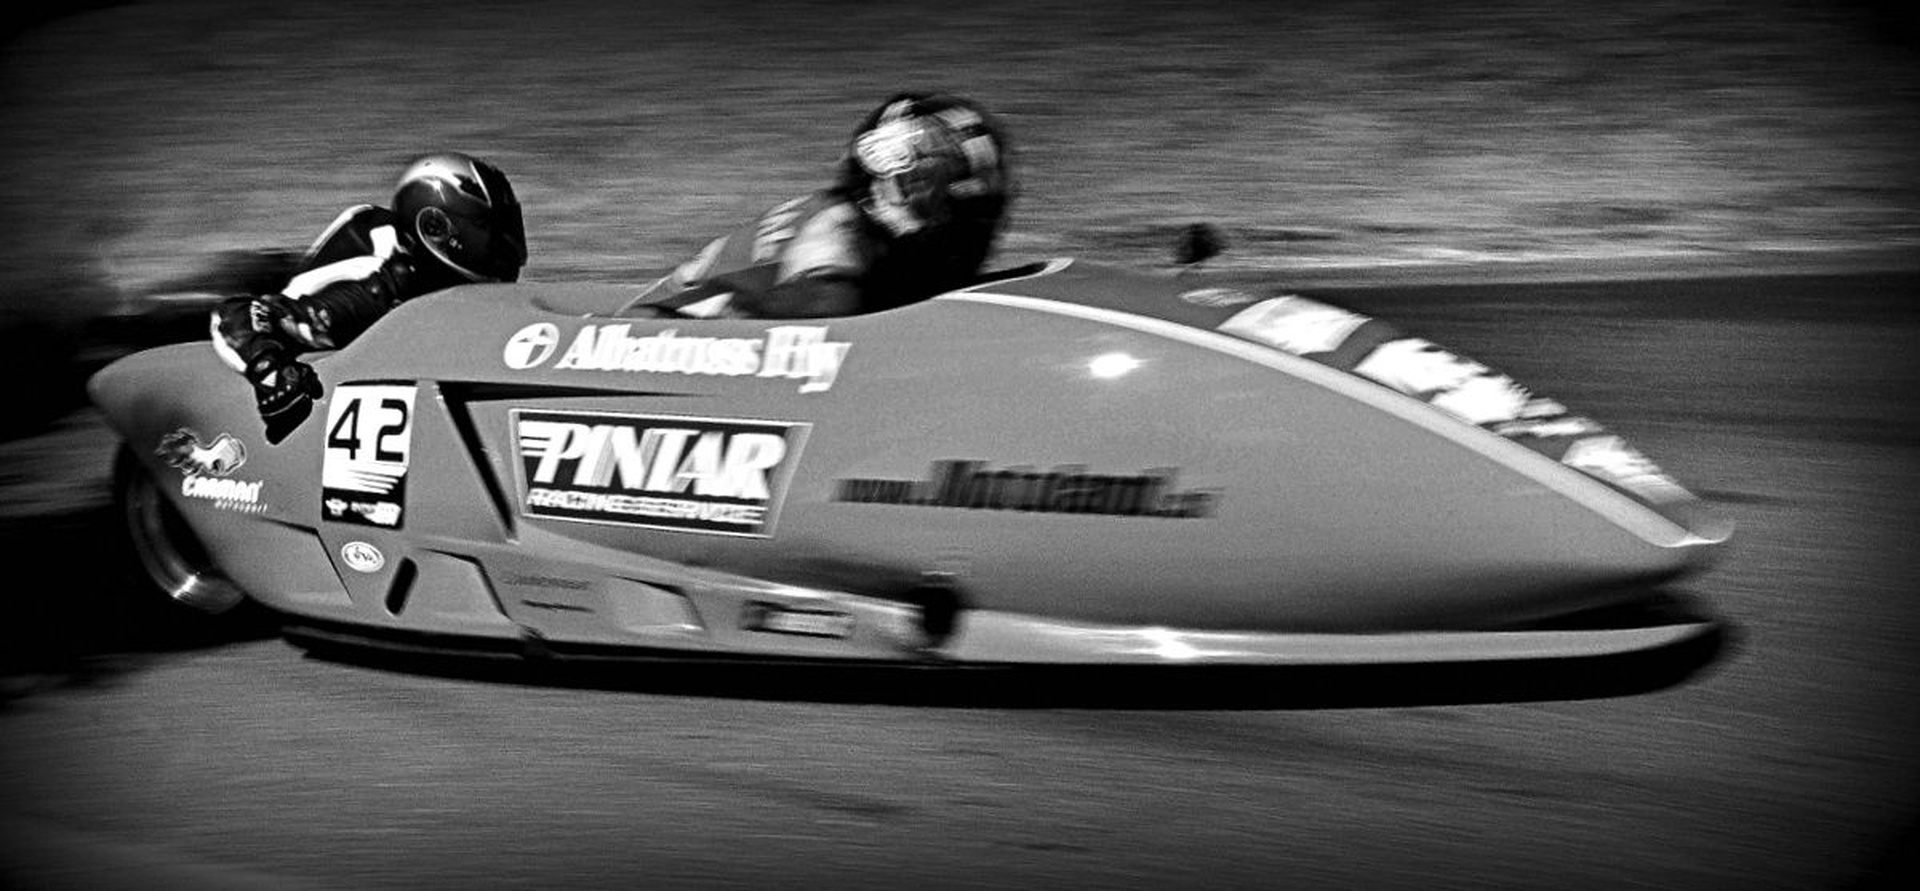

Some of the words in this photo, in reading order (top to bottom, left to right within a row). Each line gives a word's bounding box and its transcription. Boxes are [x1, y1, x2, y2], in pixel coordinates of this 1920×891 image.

[554, 323, 765, 376] Albatross
[327, 397, 409, 462] 42
[519, 420, 788, 500] PINTAR
